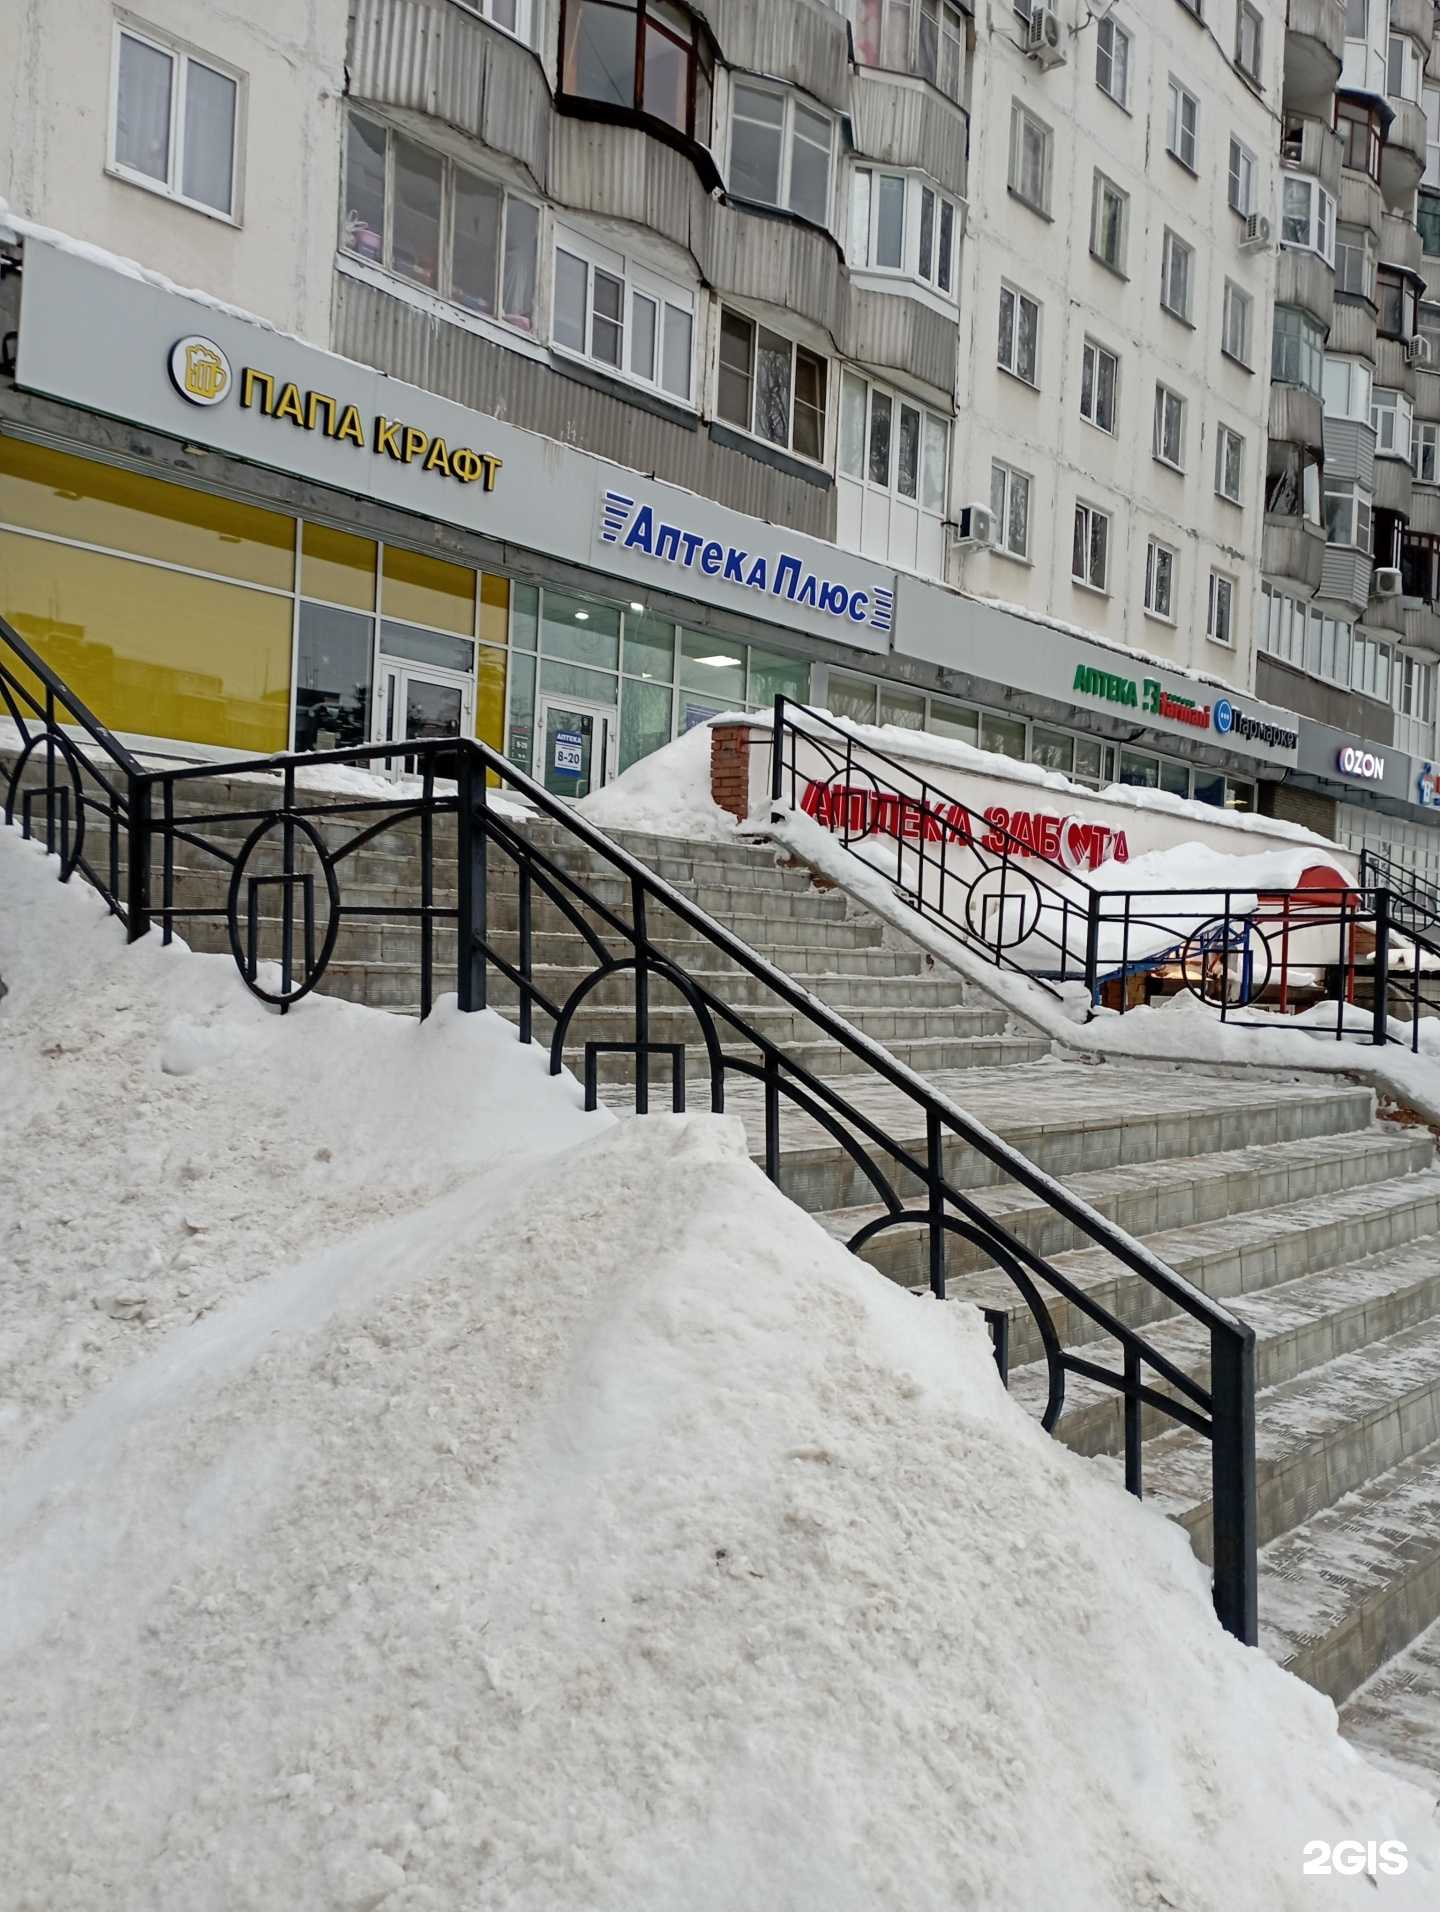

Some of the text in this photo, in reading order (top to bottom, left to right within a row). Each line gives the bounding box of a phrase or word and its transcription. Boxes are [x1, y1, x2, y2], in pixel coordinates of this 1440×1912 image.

[241, 367, 503, 492] ПАПА КРАФТ
[1073, 664, 1138, 707] АПТЕКА
[557, 751, 580, 764] 8-20
[1341, 747, 1384, 780] OZON
[800, 780, 974, 846] АПТЕКА
